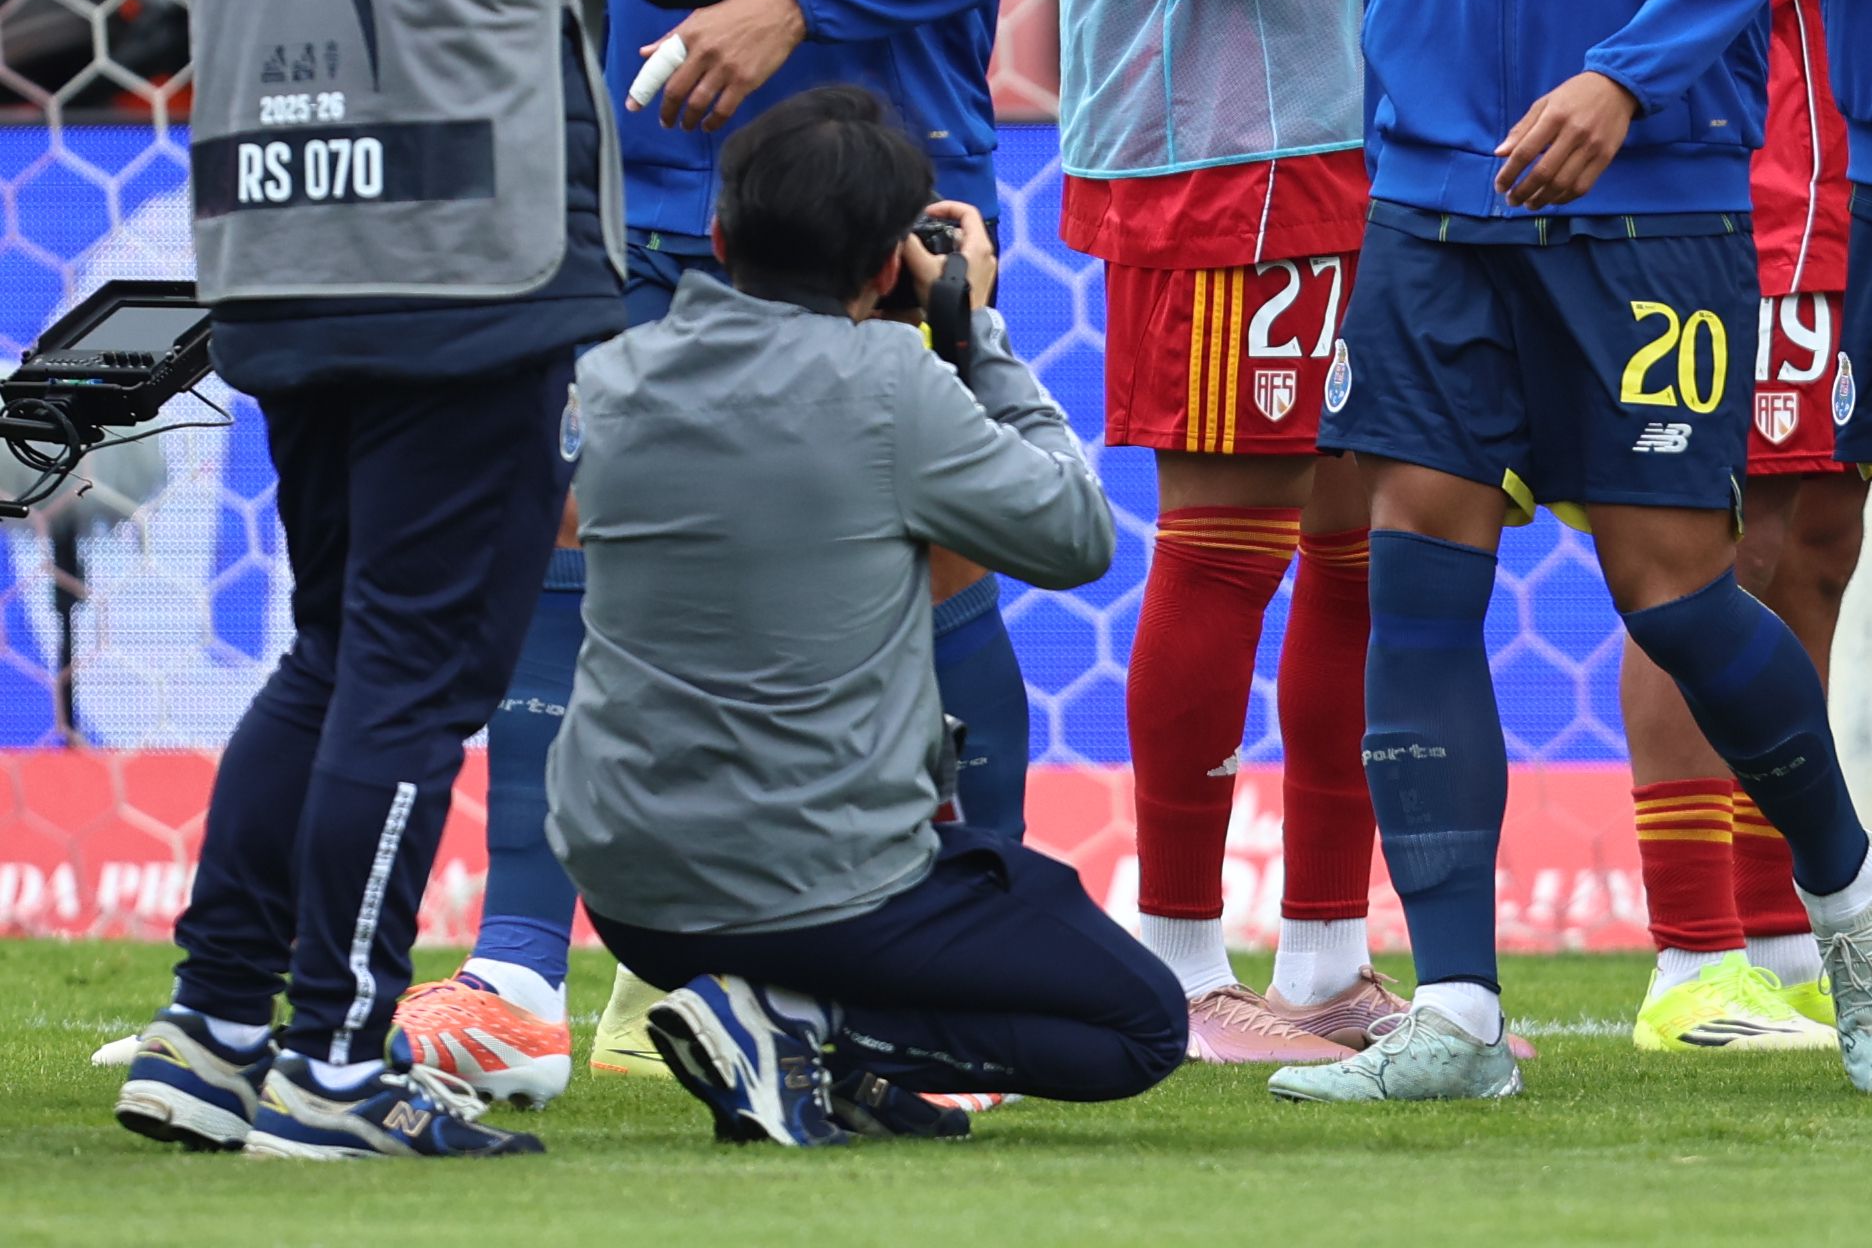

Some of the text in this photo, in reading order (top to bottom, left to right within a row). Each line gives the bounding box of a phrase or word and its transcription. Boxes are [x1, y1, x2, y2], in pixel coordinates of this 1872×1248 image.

[260, 91, 346, 125] 2025-26
[238, 137, 384, 203] RS 070
[1248, 257, 1342, 357] 27
[1755, 293, 1831, 382] 19
[1620, 301, 1728, 414] 20
[1257, 372, 1295, 418] AFS
[1756, 394, 1797, 440] AFS
